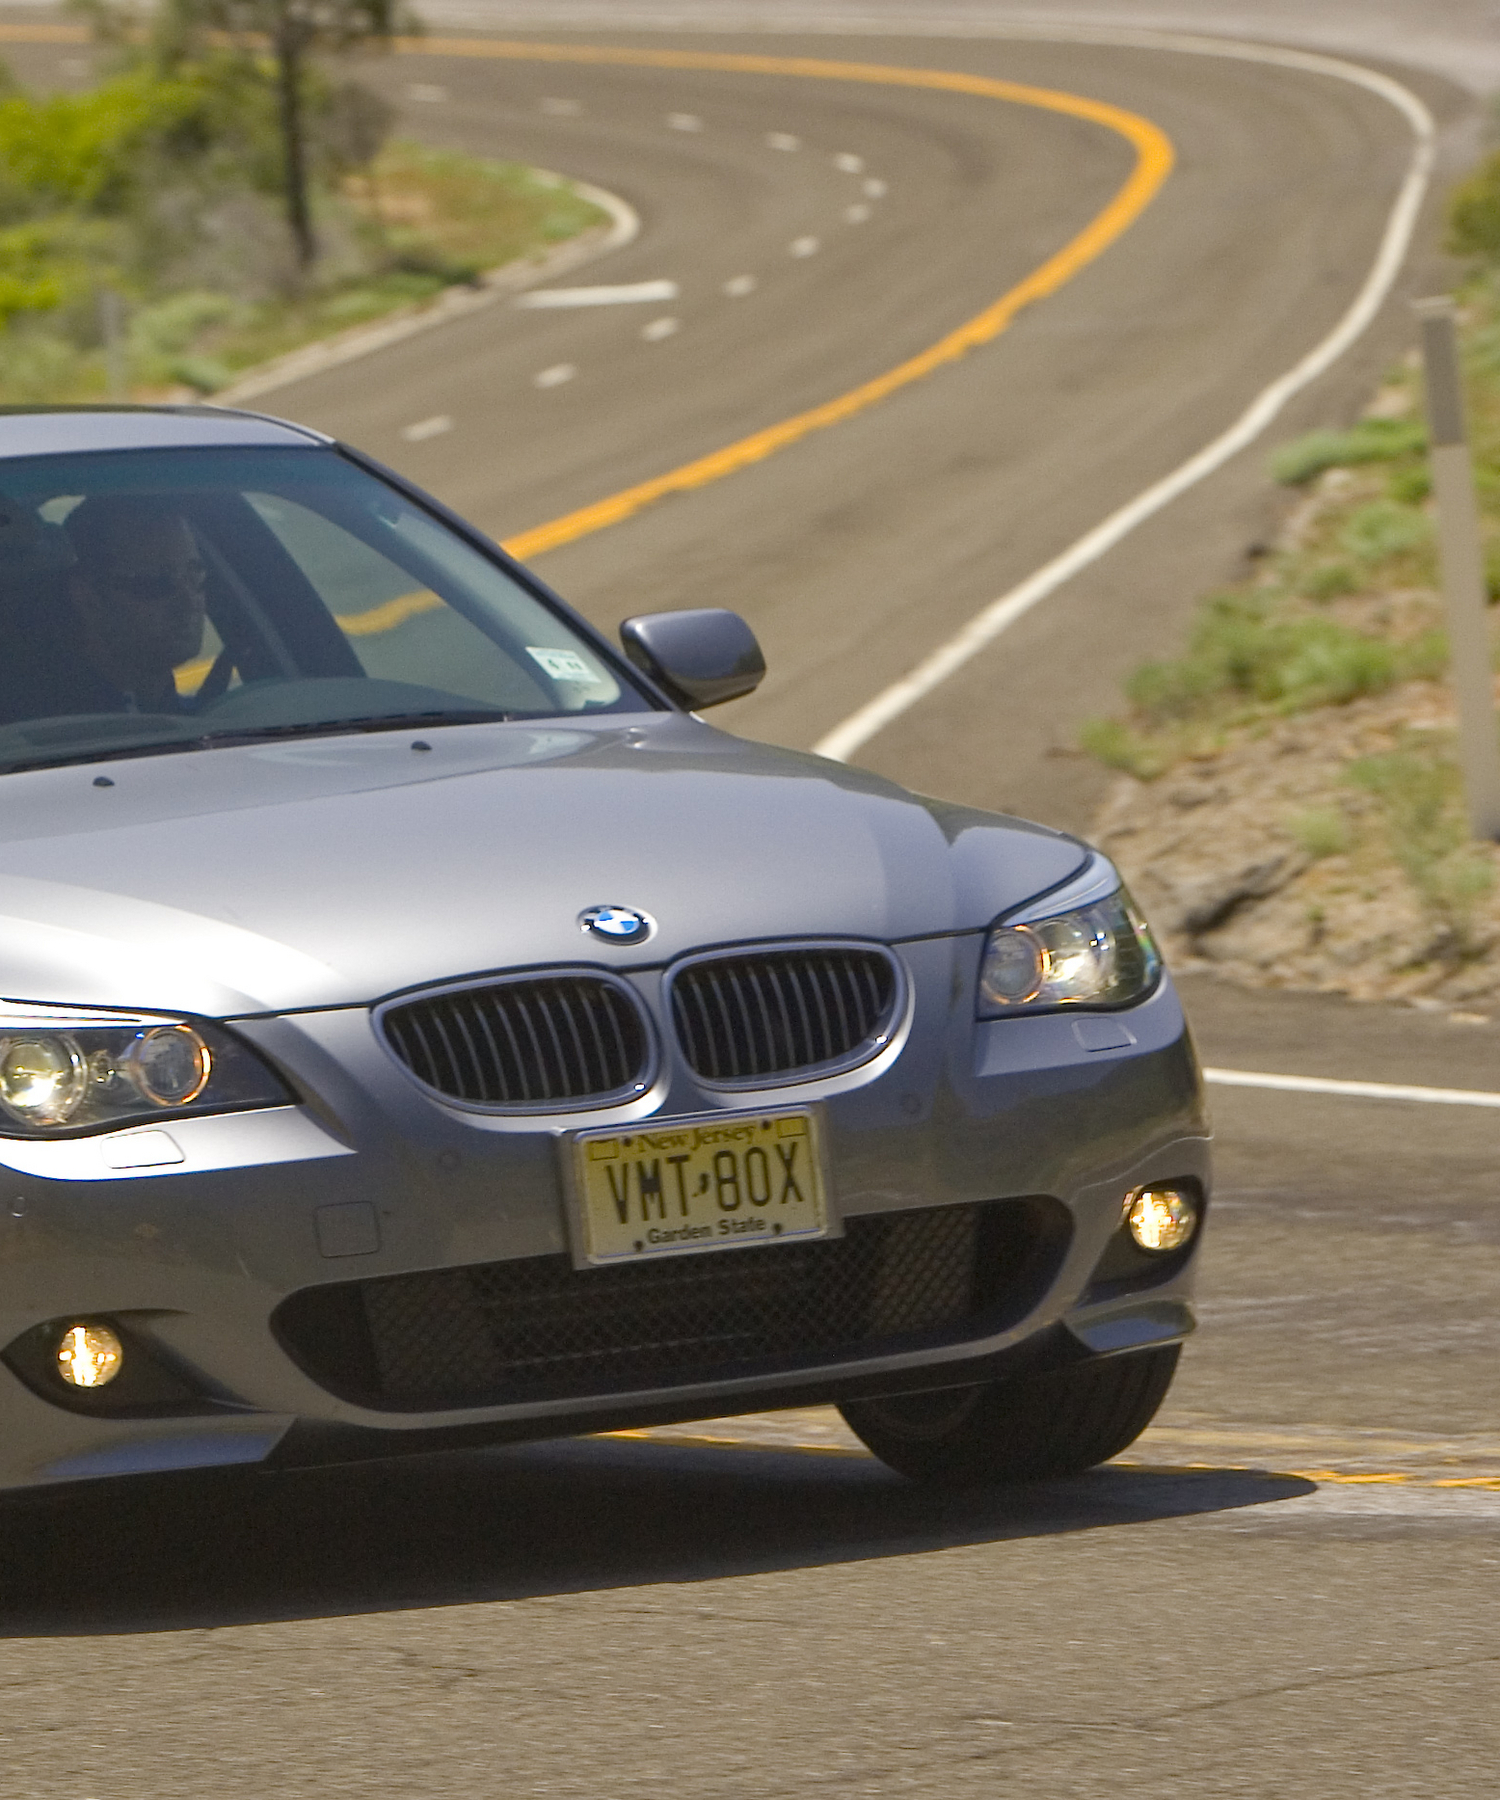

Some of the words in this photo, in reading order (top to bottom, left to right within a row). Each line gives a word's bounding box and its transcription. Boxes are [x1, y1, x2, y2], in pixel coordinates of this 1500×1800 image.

[636, 1133, 689, 1153] New
[690, 1125, 756, 1151] Jersey
[647, 1224, 713, 1244] Garden
[718, 1216, 767, 1236] State
